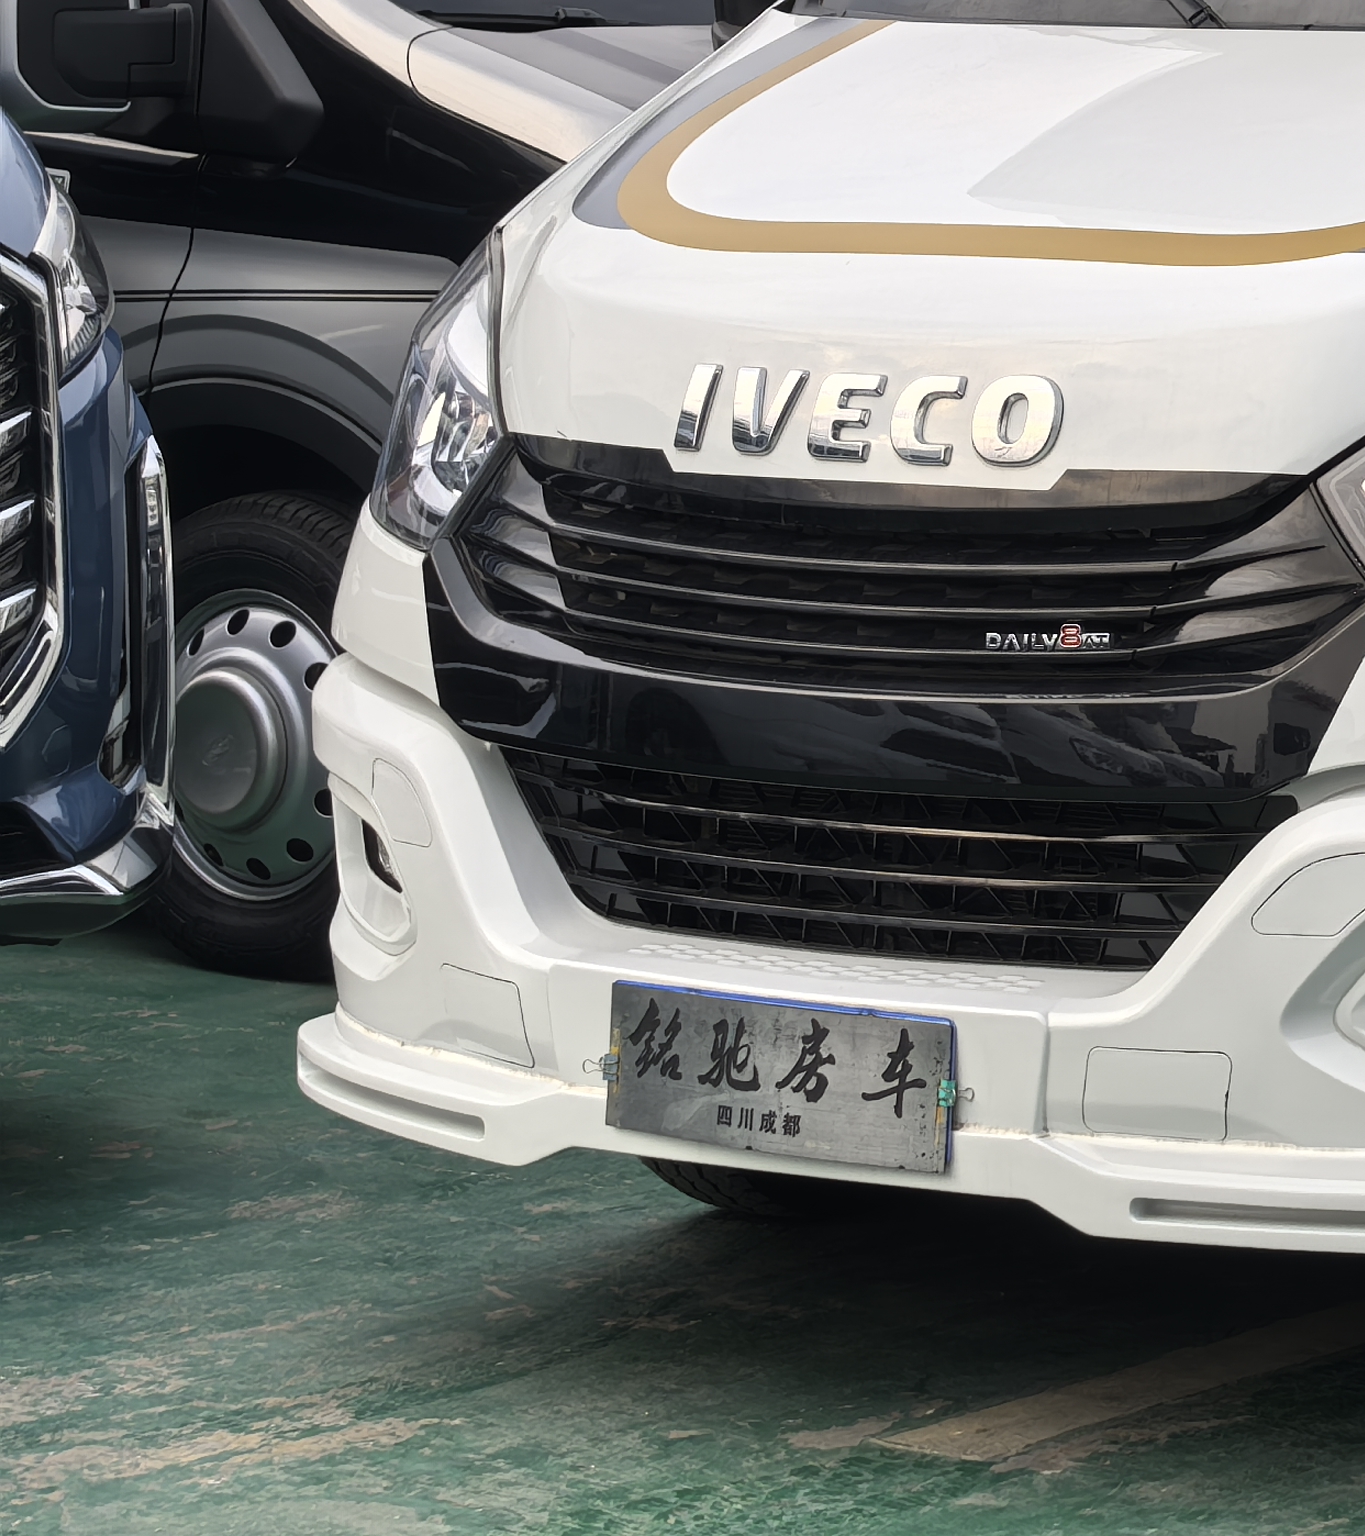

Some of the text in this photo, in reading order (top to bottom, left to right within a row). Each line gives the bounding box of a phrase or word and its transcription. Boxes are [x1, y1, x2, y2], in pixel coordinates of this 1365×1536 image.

[673, 362, 1064, 467] IVECO
[716, 1104, 802, 1138] 四川成都
